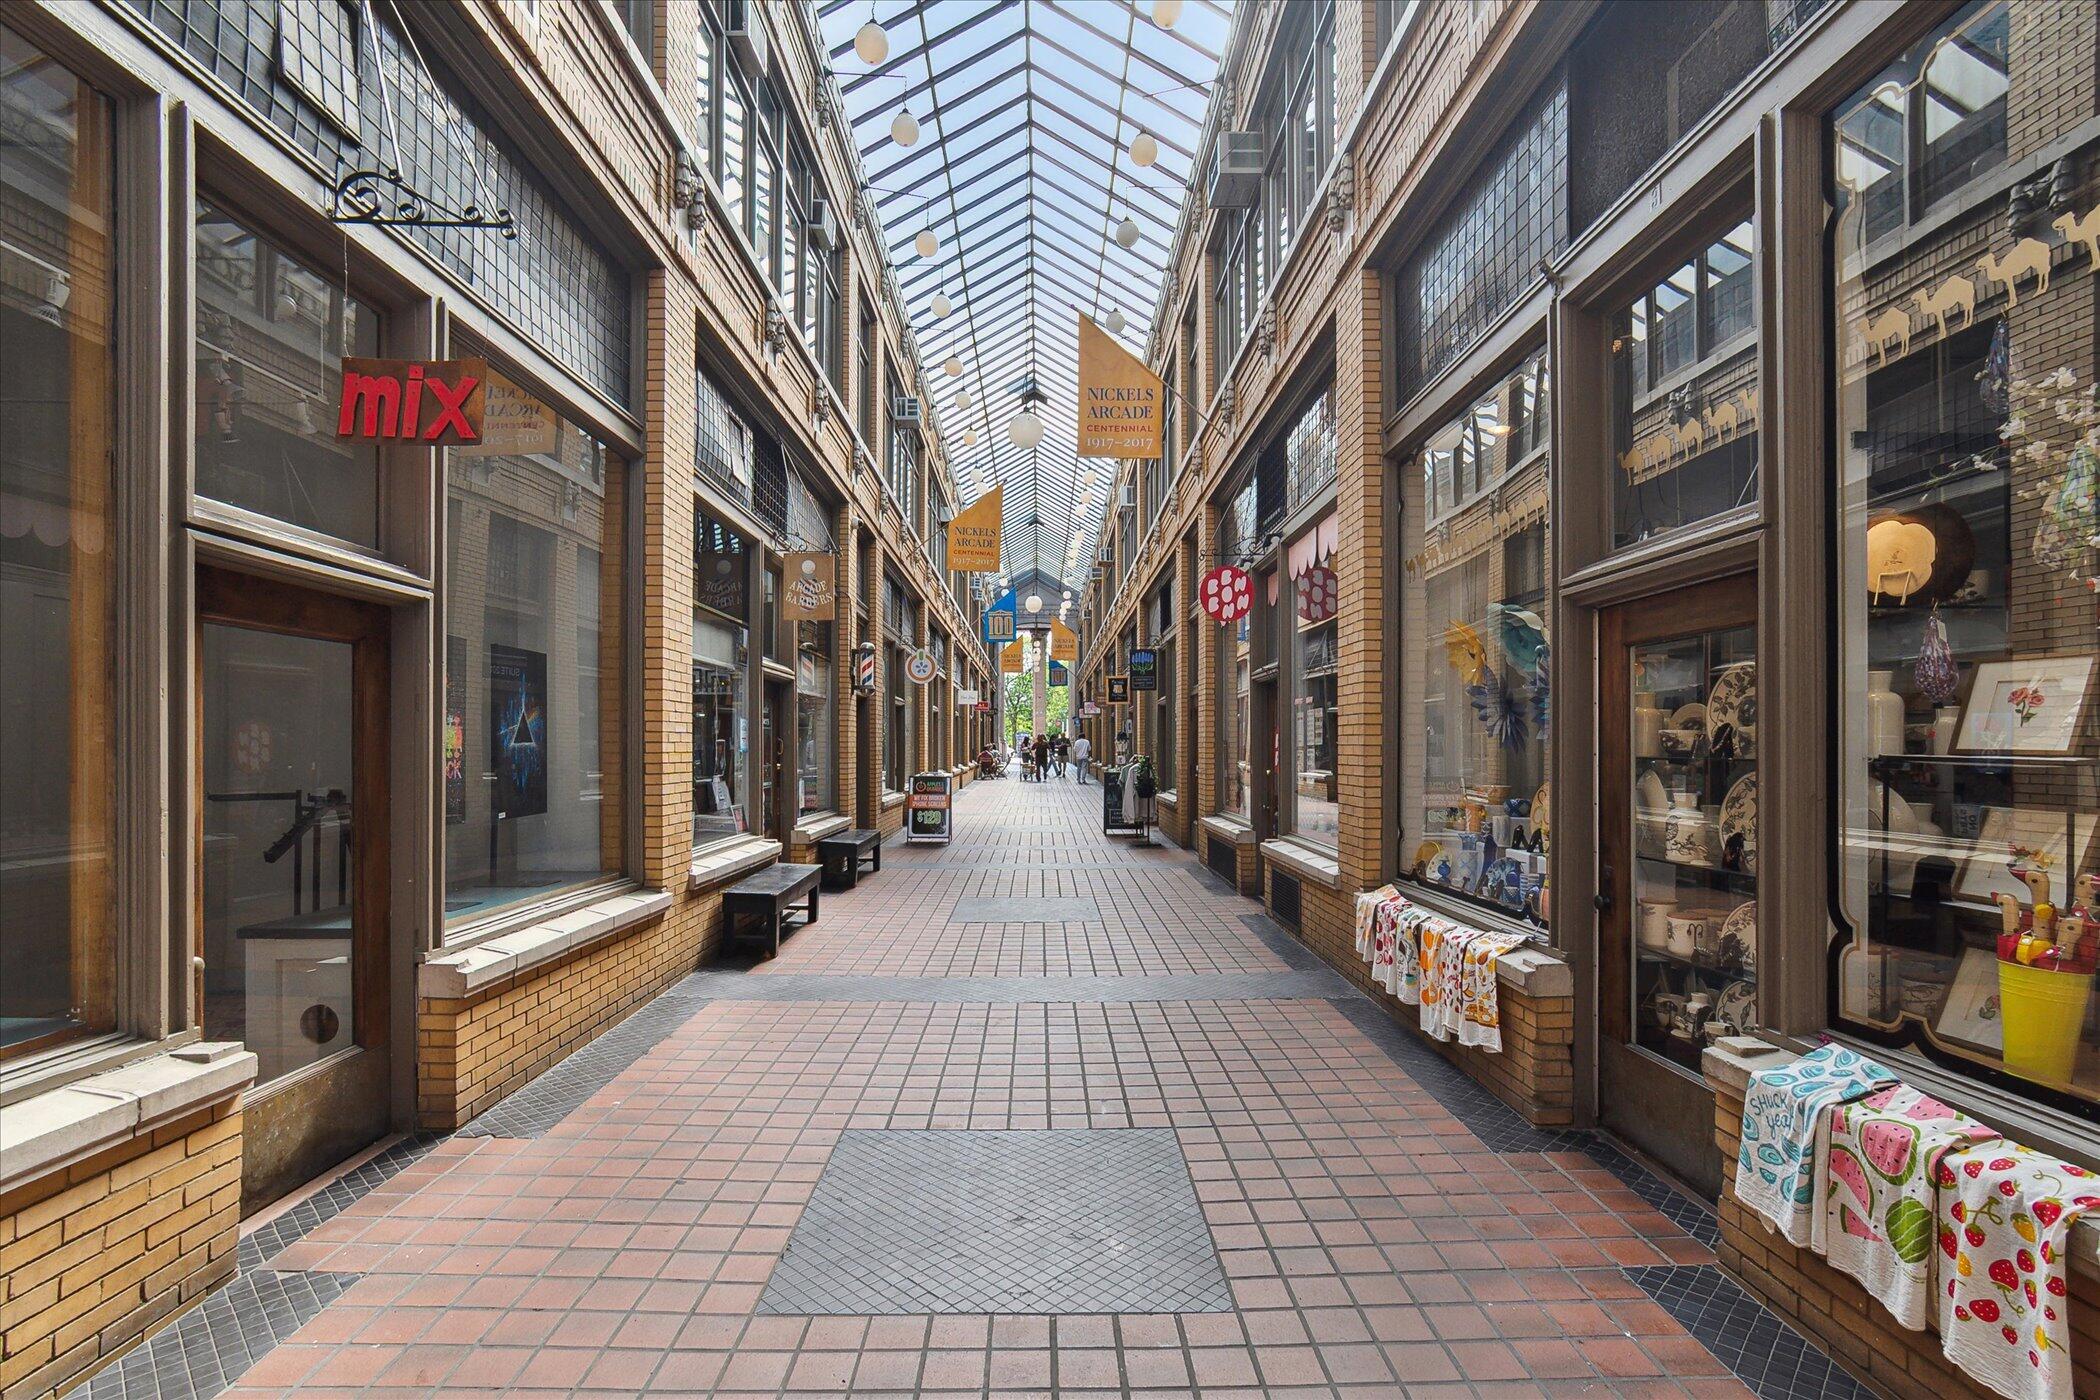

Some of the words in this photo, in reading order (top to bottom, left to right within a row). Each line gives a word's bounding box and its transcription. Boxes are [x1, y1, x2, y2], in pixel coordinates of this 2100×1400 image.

[1087, 387, 1154, 401] NICKELS
[339, 365, 480, 438] mix
[1087, 406, 1154, 419] ARCADE
[1086, 424, 1153, 433] CENTENNIAL
[955, 526, 996, 537] NICKELS
[954, 537, 995, 548] ARCADE
[953, 549, 994, 557] CENTENNIAL
[789, 579, 828, 595] ARCADE
[785, 592, 833, 609] BARBERS
[1750, 1093, 1789, 1116] SHUCK
